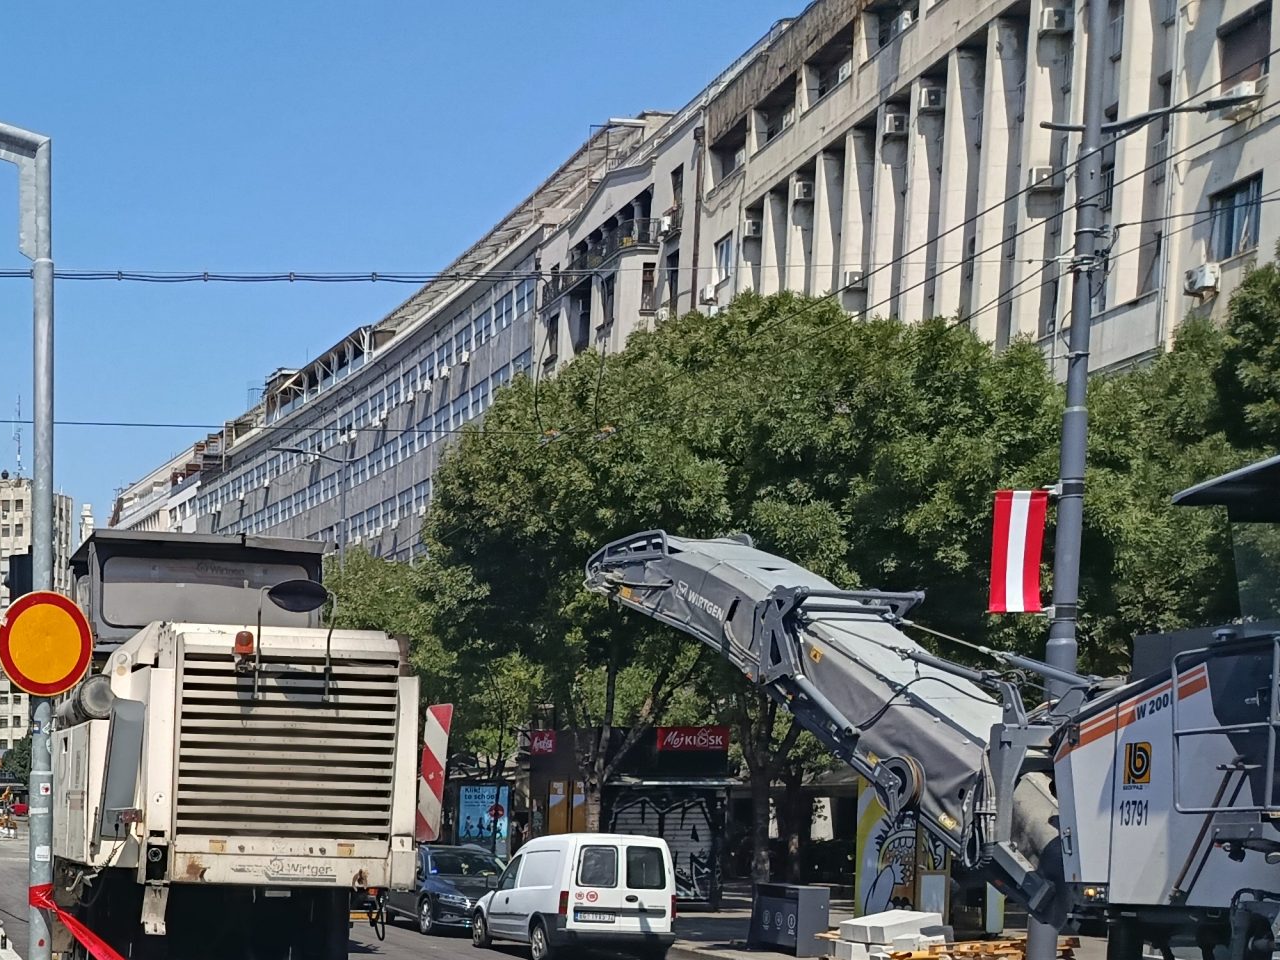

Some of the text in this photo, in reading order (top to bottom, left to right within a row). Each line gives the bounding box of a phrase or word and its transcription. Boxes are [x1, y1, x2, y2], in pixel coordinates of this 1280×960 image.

[687, 589, 725, 621] WIRTGEN
[1136, 703, 1146, 720] W
[1120, 800, 1149, 826] 13791
